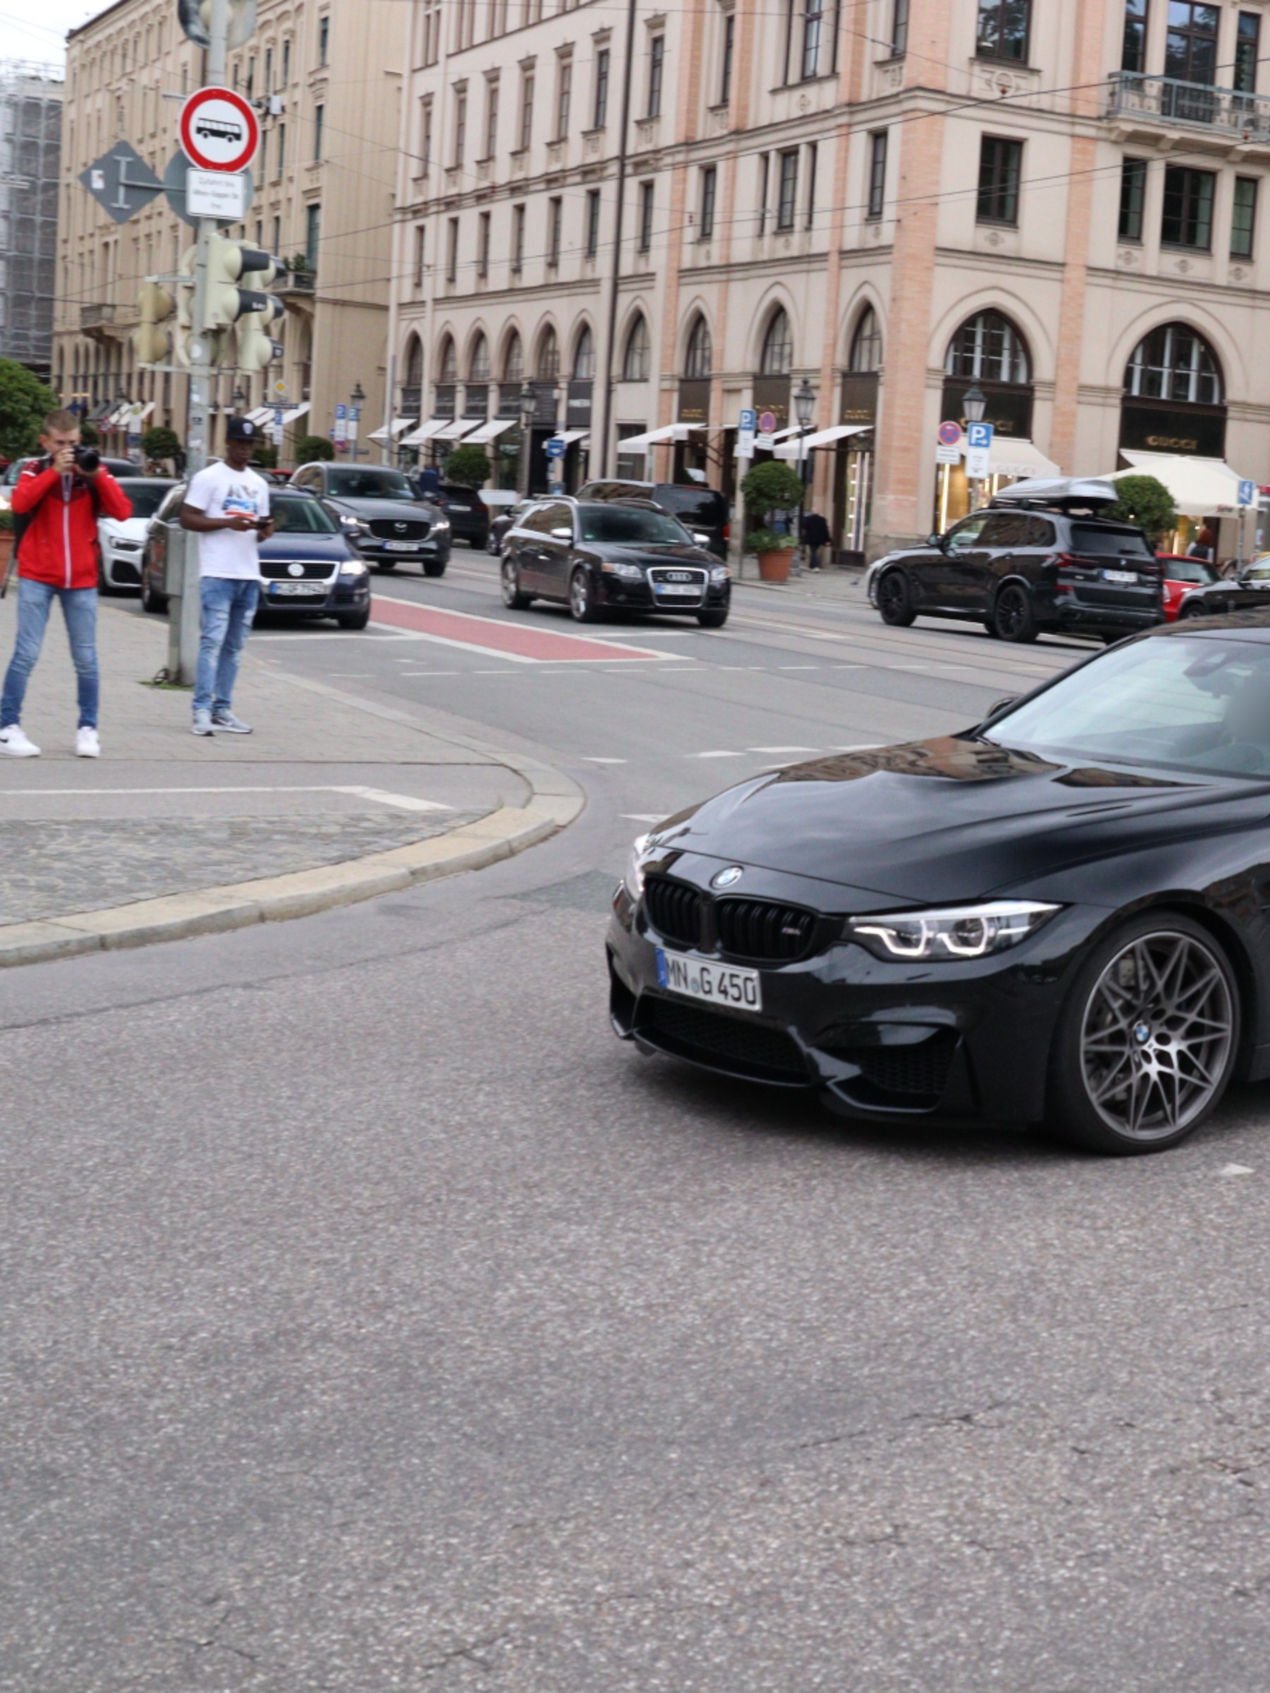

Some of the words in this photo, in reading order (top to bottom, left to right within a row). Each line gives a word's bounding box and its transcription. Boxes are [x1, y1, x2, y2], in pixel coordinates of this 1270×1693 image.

[970, 426, 986, 444] P
[1146, 436, 1198, 450] GUCCI
[666, 957, 689, 990] MN
[700, 967, 713, 996] G
[718, 972, 757, 1005] 450
